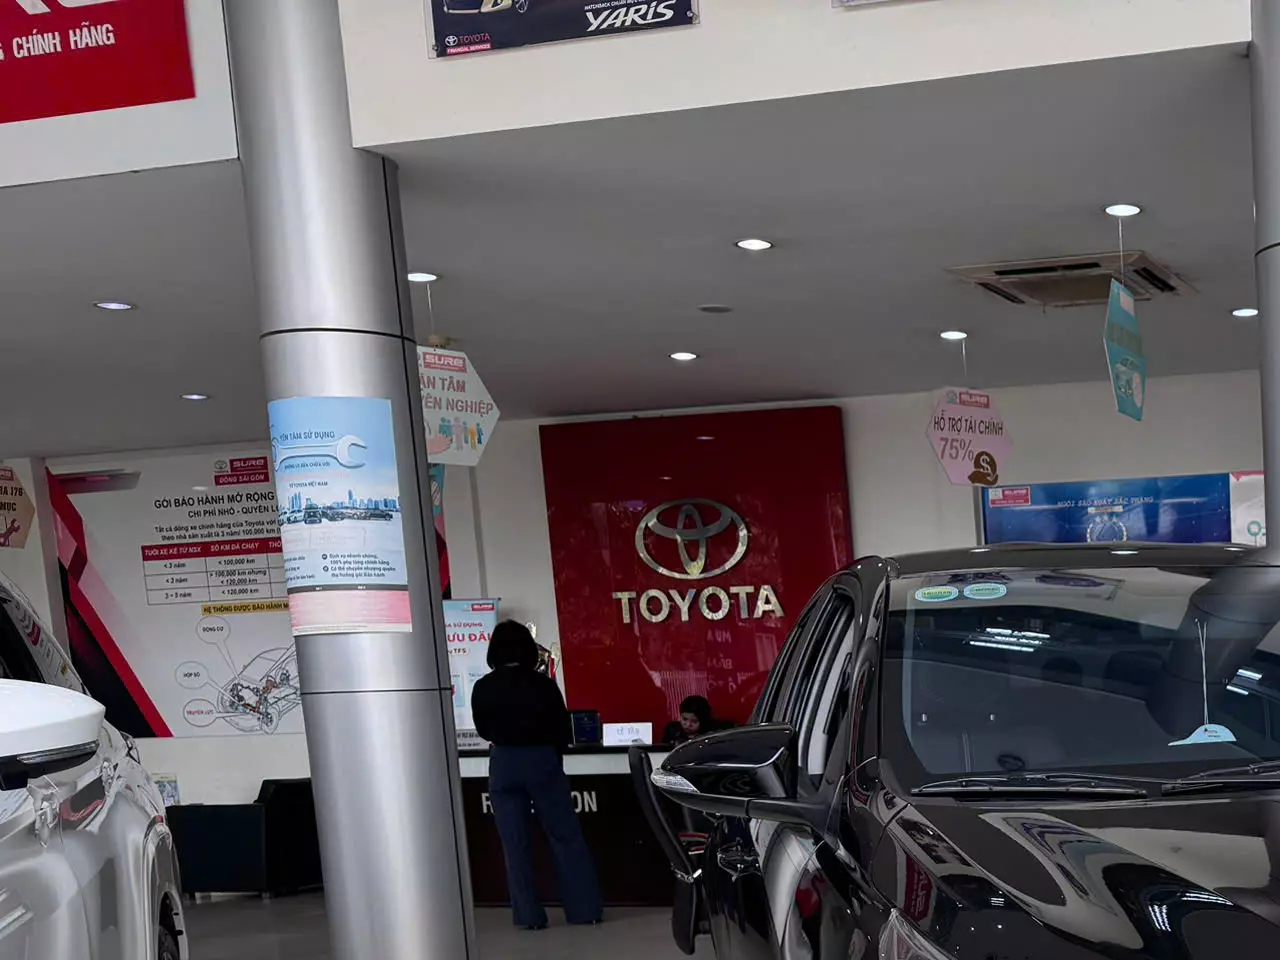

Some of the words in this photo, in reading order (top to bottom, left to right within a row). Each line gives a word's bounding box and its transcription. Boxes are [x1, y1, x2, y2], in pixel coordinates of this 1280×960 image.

[12, 28, 62, 59] CHÍNH
[69, 21, 116, 50] HÃNG
[459, 33, 490, 45] TOYOTA
[469, 43, 491, 52] SERVICES
[439, 375, 466, 393] TÂM
[446, 399, 494, 418] NGHIỆP
[933, 409, 946, 432] HỖ
[948, 416, 962, 436] TRỢ
[964, 416, 977, 434] TÀI
[978, 417, 1003, 437] CHÍNH
[940, 436, 974, 462] 75%
[154, 498, 172, 509] GÓI
[174, 495, 195, 507] BẢO
[197, 493, 224, 506] HÀNH
[227, 492, 243, 504] MỞ
[246, 491, 275, 503] RỘNG
[188, 510, 201, 518] CHI
[241, 505, 268, 516] QUYỀN
[612, 584, 785, 624] TOYOTA
